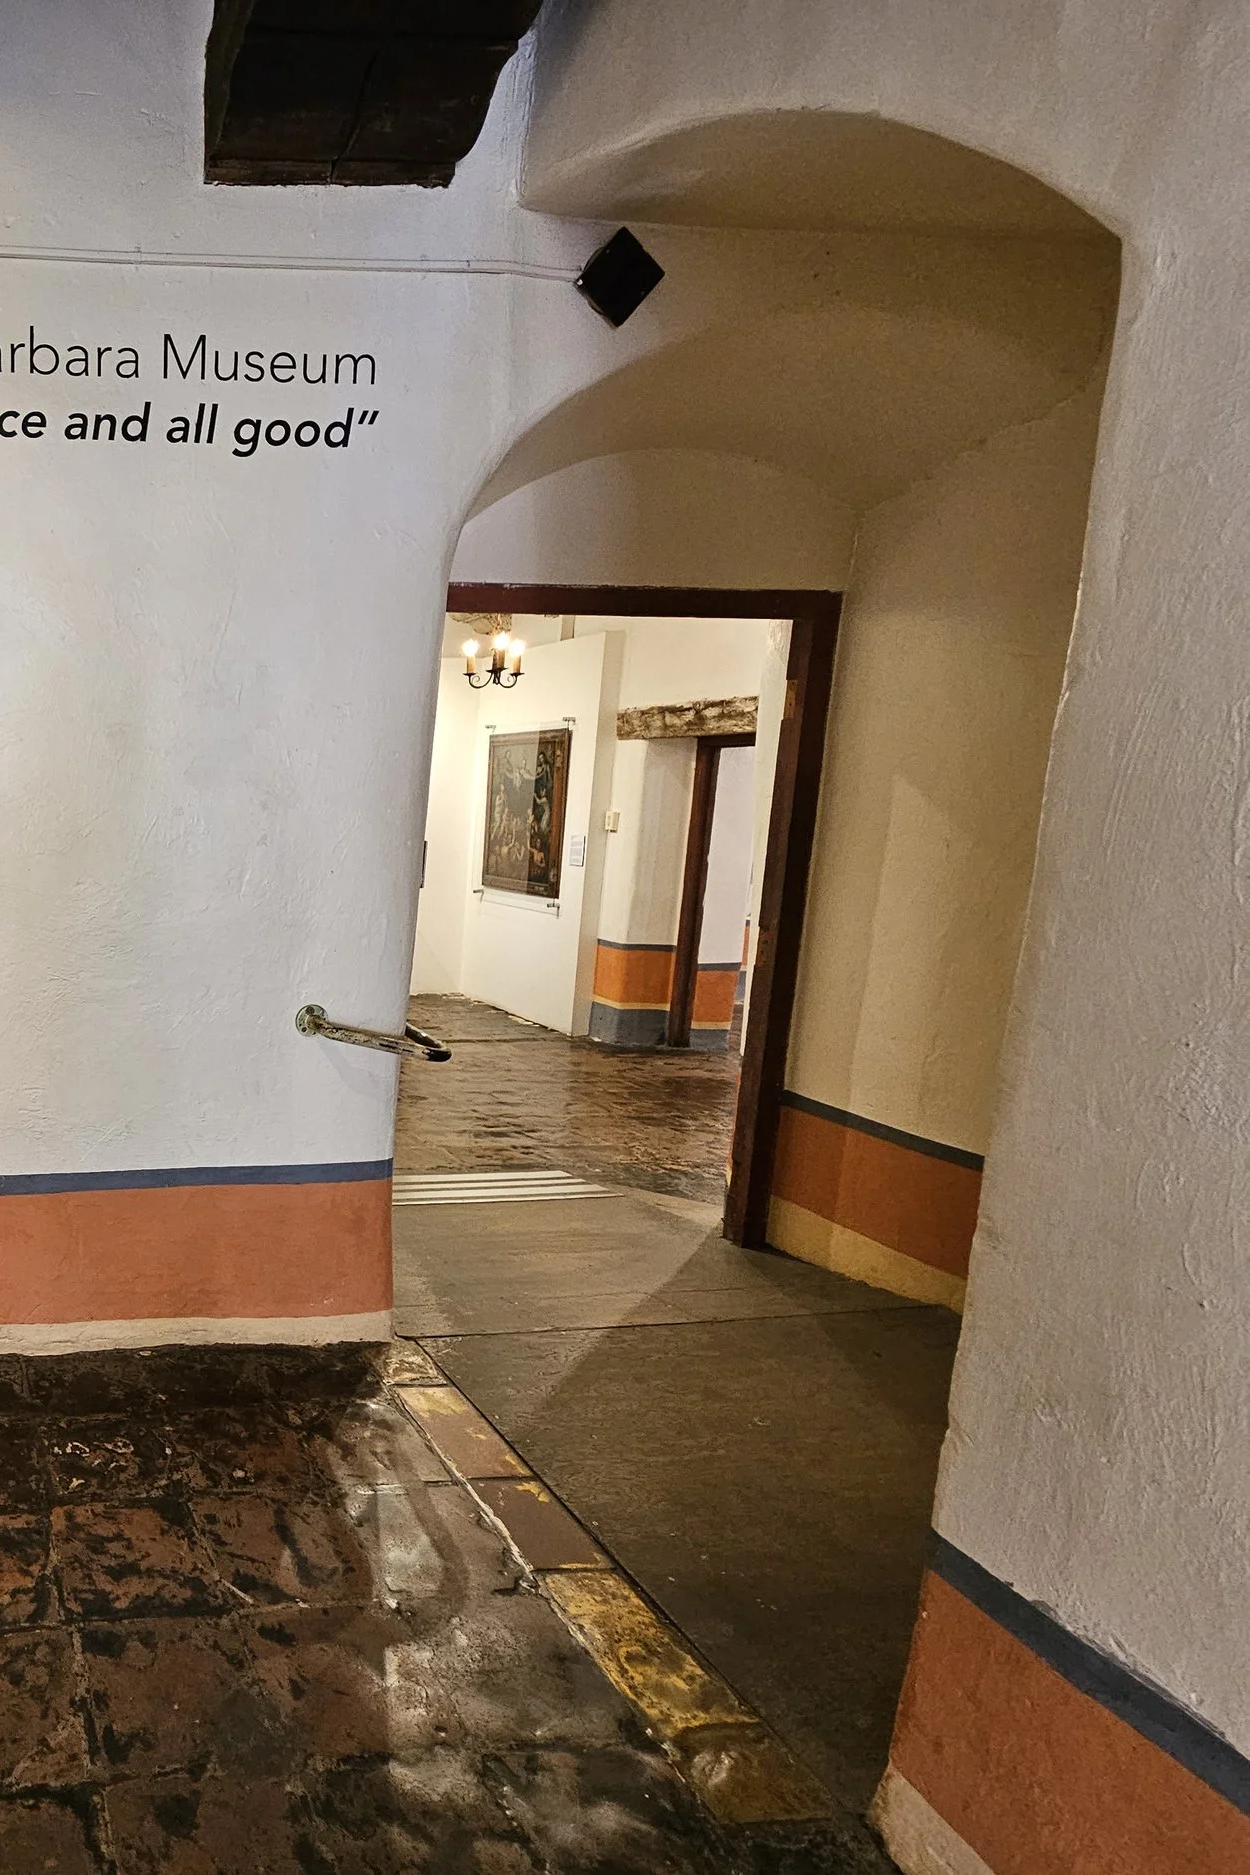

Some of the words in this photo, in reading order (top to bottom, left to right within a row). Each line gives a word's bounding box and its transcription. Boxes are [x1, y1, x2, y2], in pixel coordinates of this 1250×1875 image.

[162, 333, 377, 386] Museum
[64, 402, 152, 443] and
[166, 402, 219, 445] all
[232, 408, 380, 458] good”
